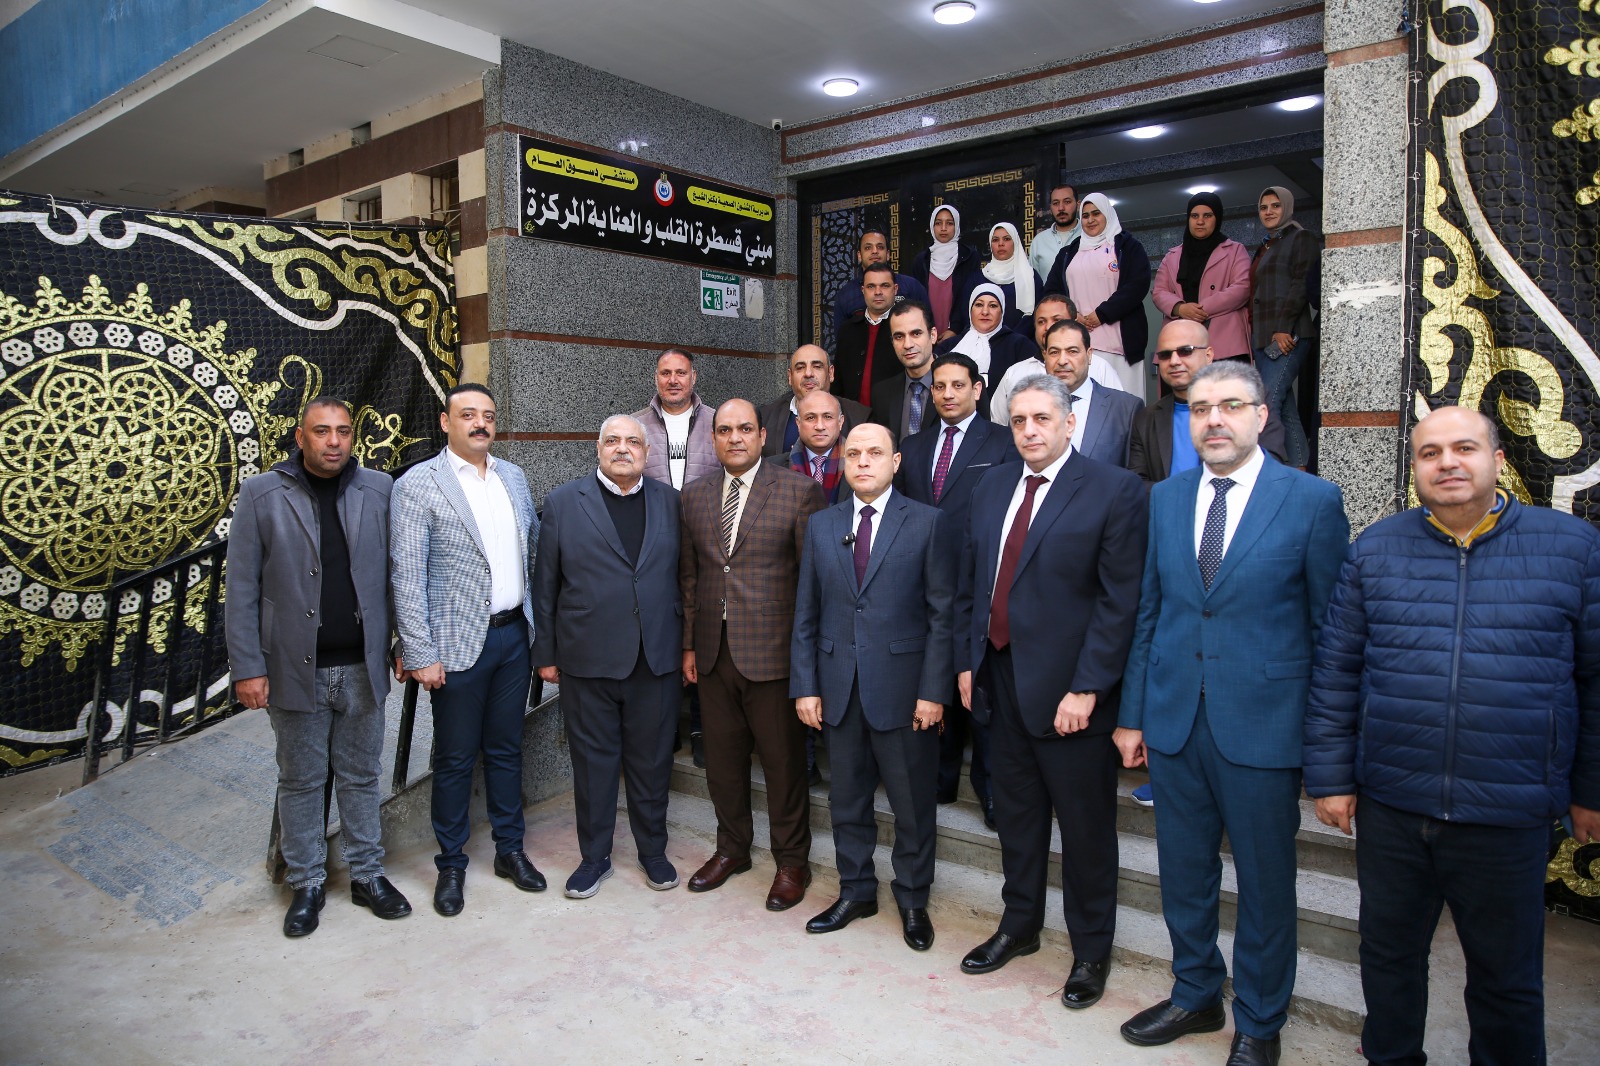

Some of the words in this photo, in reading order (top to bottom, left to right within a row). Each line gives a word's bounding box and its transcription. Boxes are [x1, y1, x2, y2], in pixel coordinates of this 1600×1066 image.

[526, 186, 585, 230] المركزة
[693, 191, 708, 203] الشيخ
[655, 216, 694, 246] القلب
[695, 221, 742, 255] قسطرة
[745, 235, 773, 266] مبني
[726, 287, 737, 297] Exit
